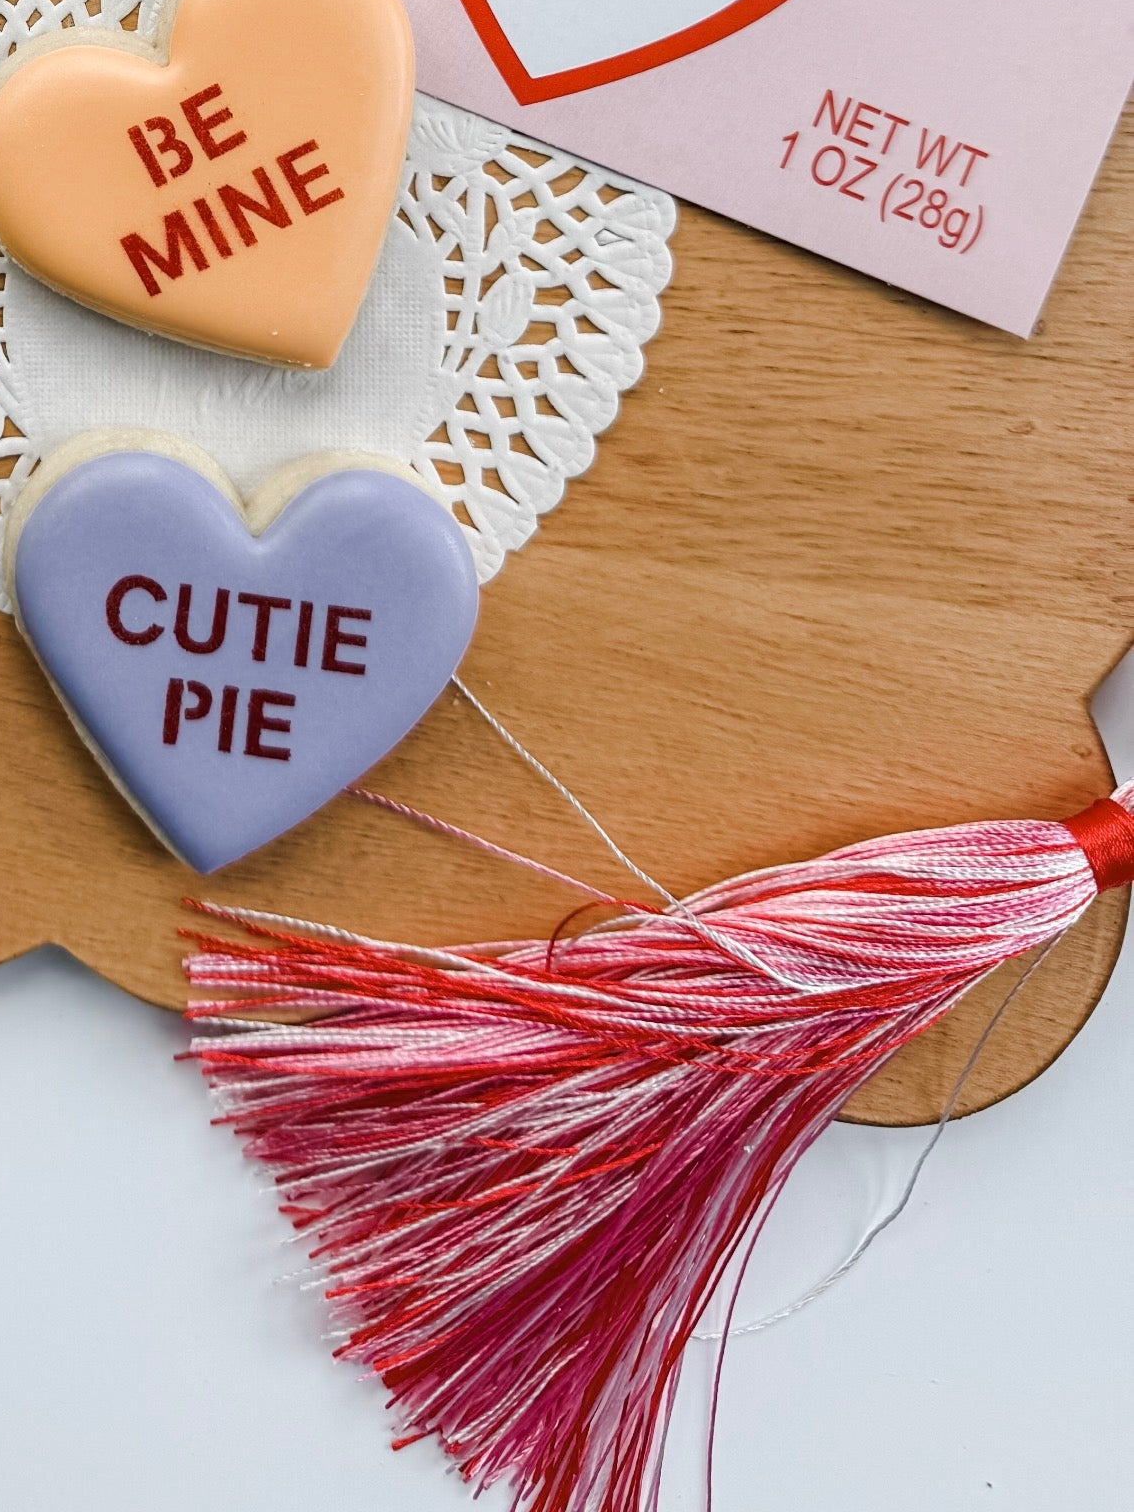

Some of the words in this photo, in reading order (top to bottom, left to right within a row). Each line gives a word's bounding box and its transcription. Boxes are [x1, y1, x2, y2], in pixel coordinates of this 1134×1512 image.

[127, 83, 248, 189] BE
[812, 88, 911, 156] NET
[915, 127, 990, 187] WT
[119, 138, 345, 298] MINE
[779, 131, 800, 170] 1
[811, 145, 879, 202] OZ
[880, 173, 984, 255] (28g)
[105, 574, 372, 676] CUTIE
[162, 677, 297, 762] PIE
